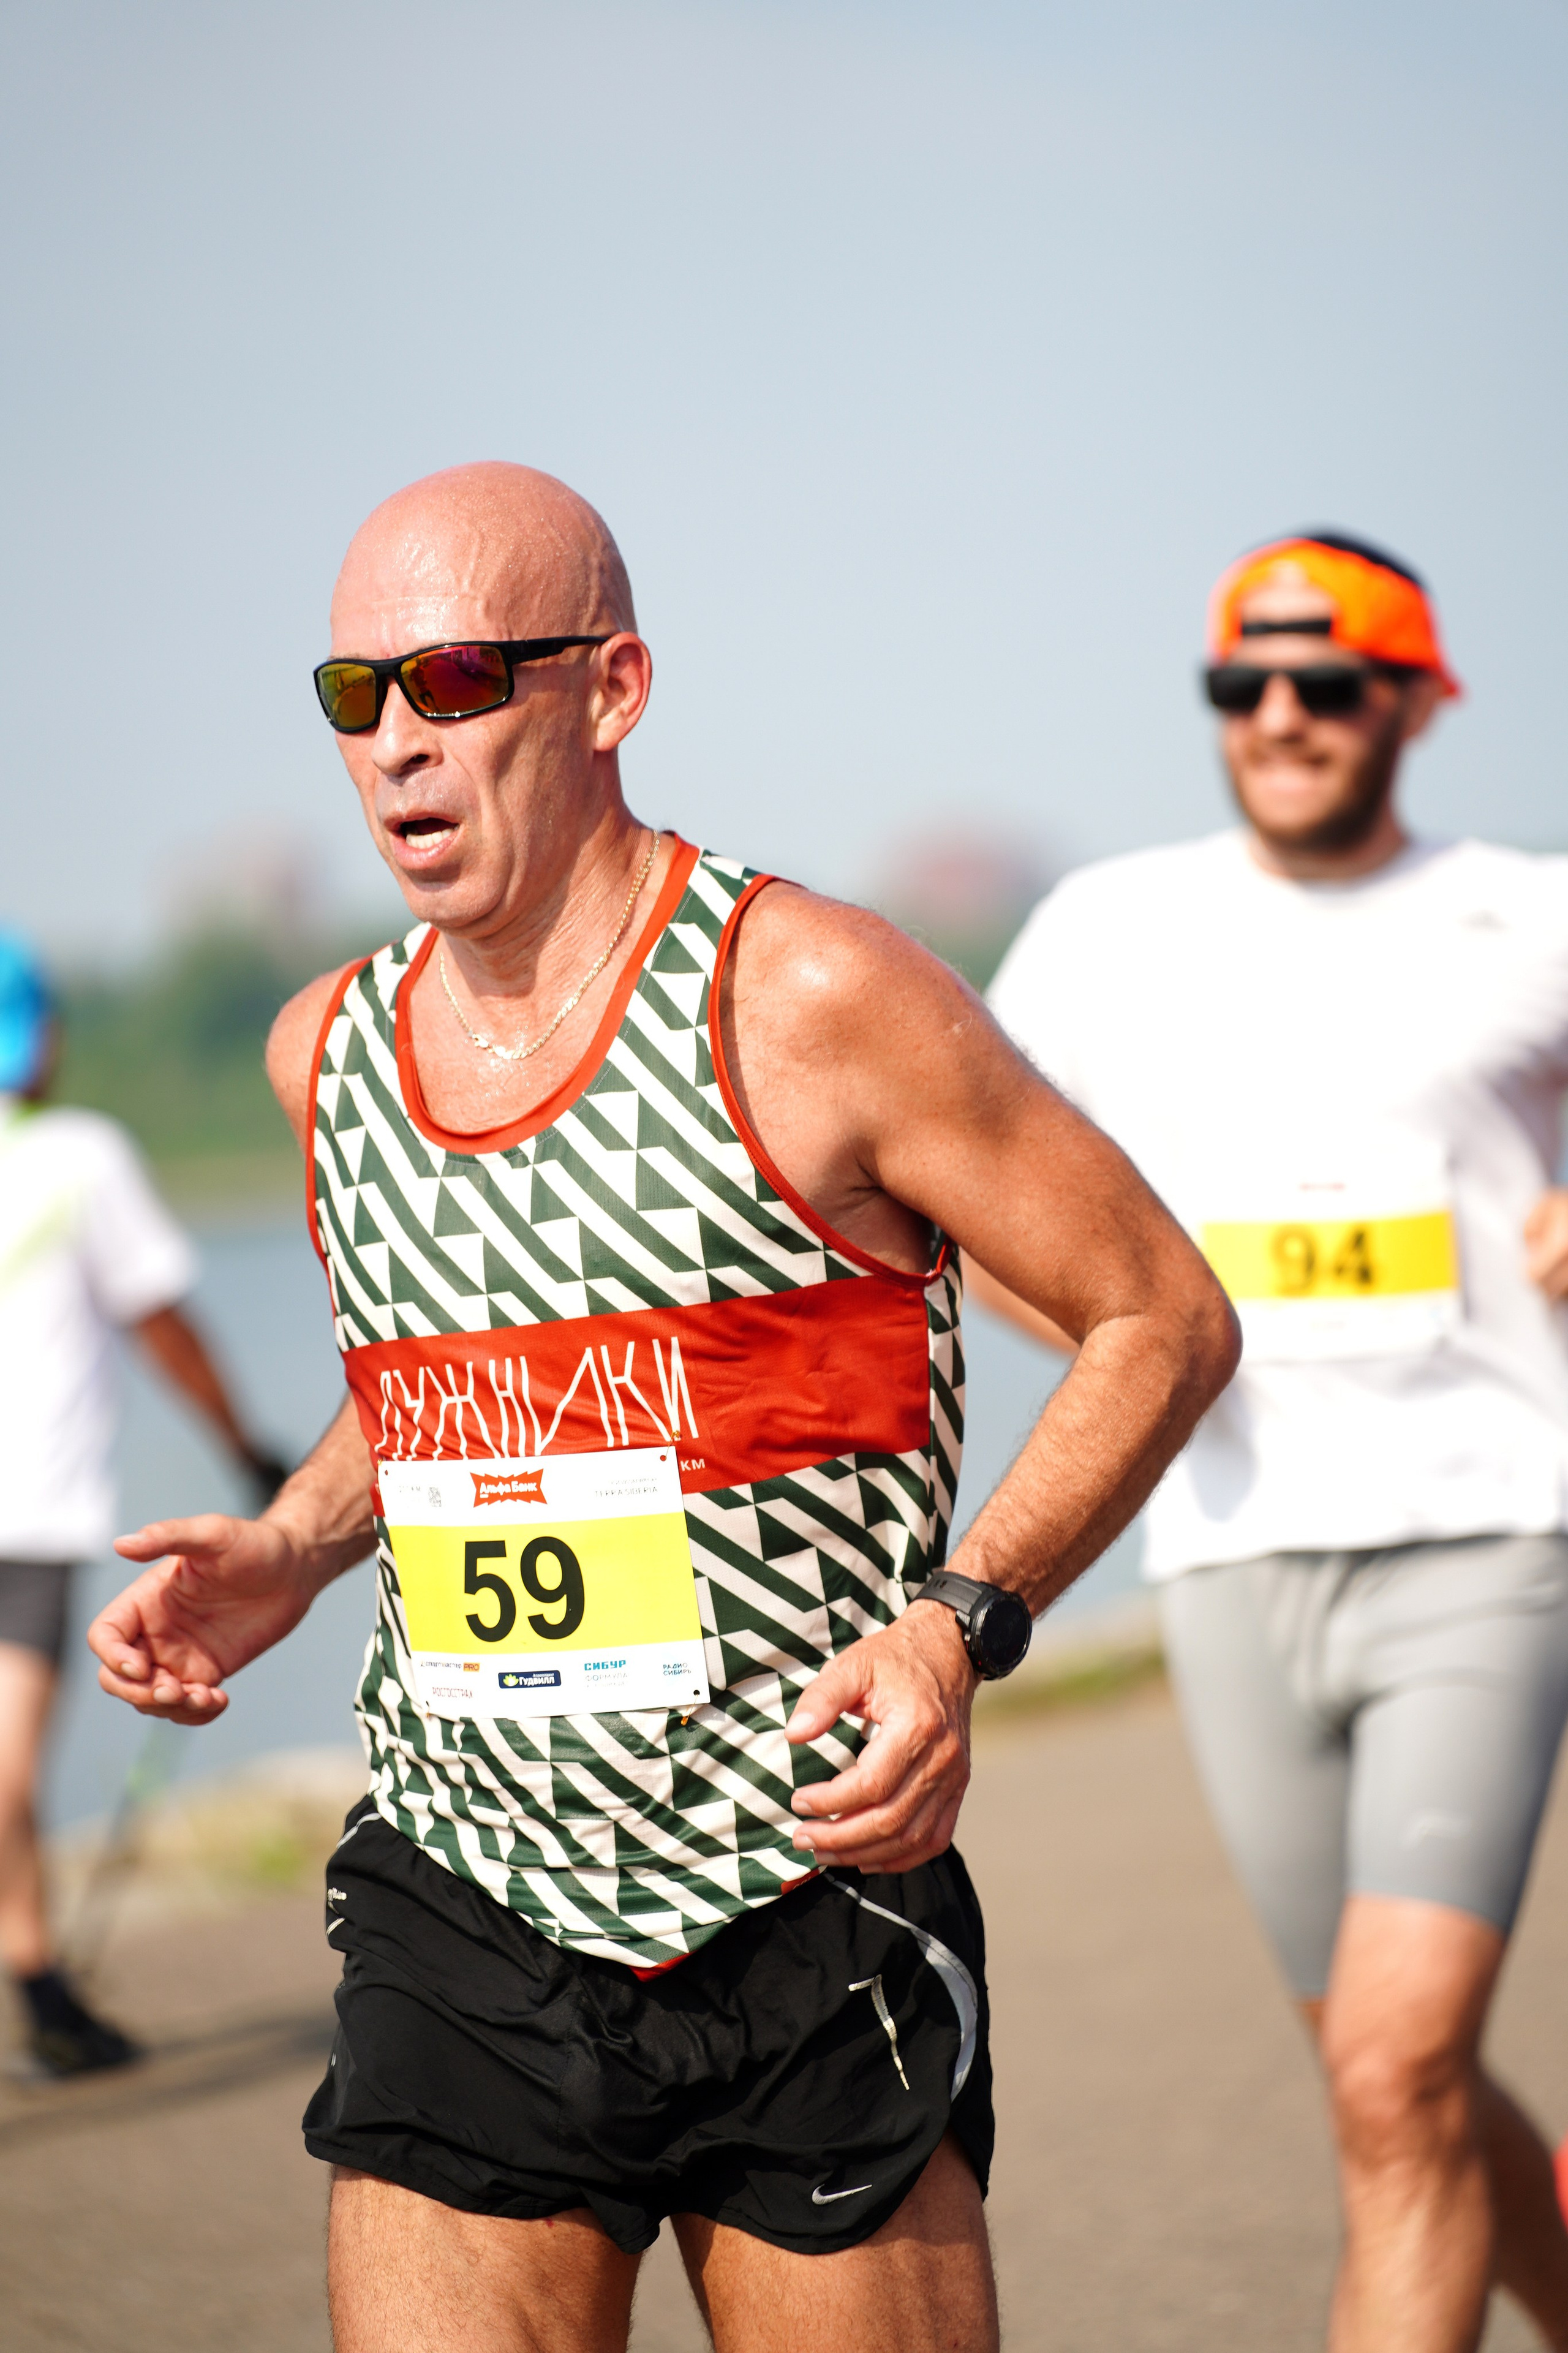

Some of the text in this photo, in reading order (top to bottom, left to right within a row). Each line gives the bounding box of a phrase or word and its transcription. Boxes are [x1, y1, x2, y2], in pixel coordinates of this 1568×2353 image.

[1272, 1223, 1378, 1297] 94
[464, 1536, 585, 1642] 59
[519, 1676, 555, 1686] Гудвилл
[584, 1660, 627, 1671] СИБУР
